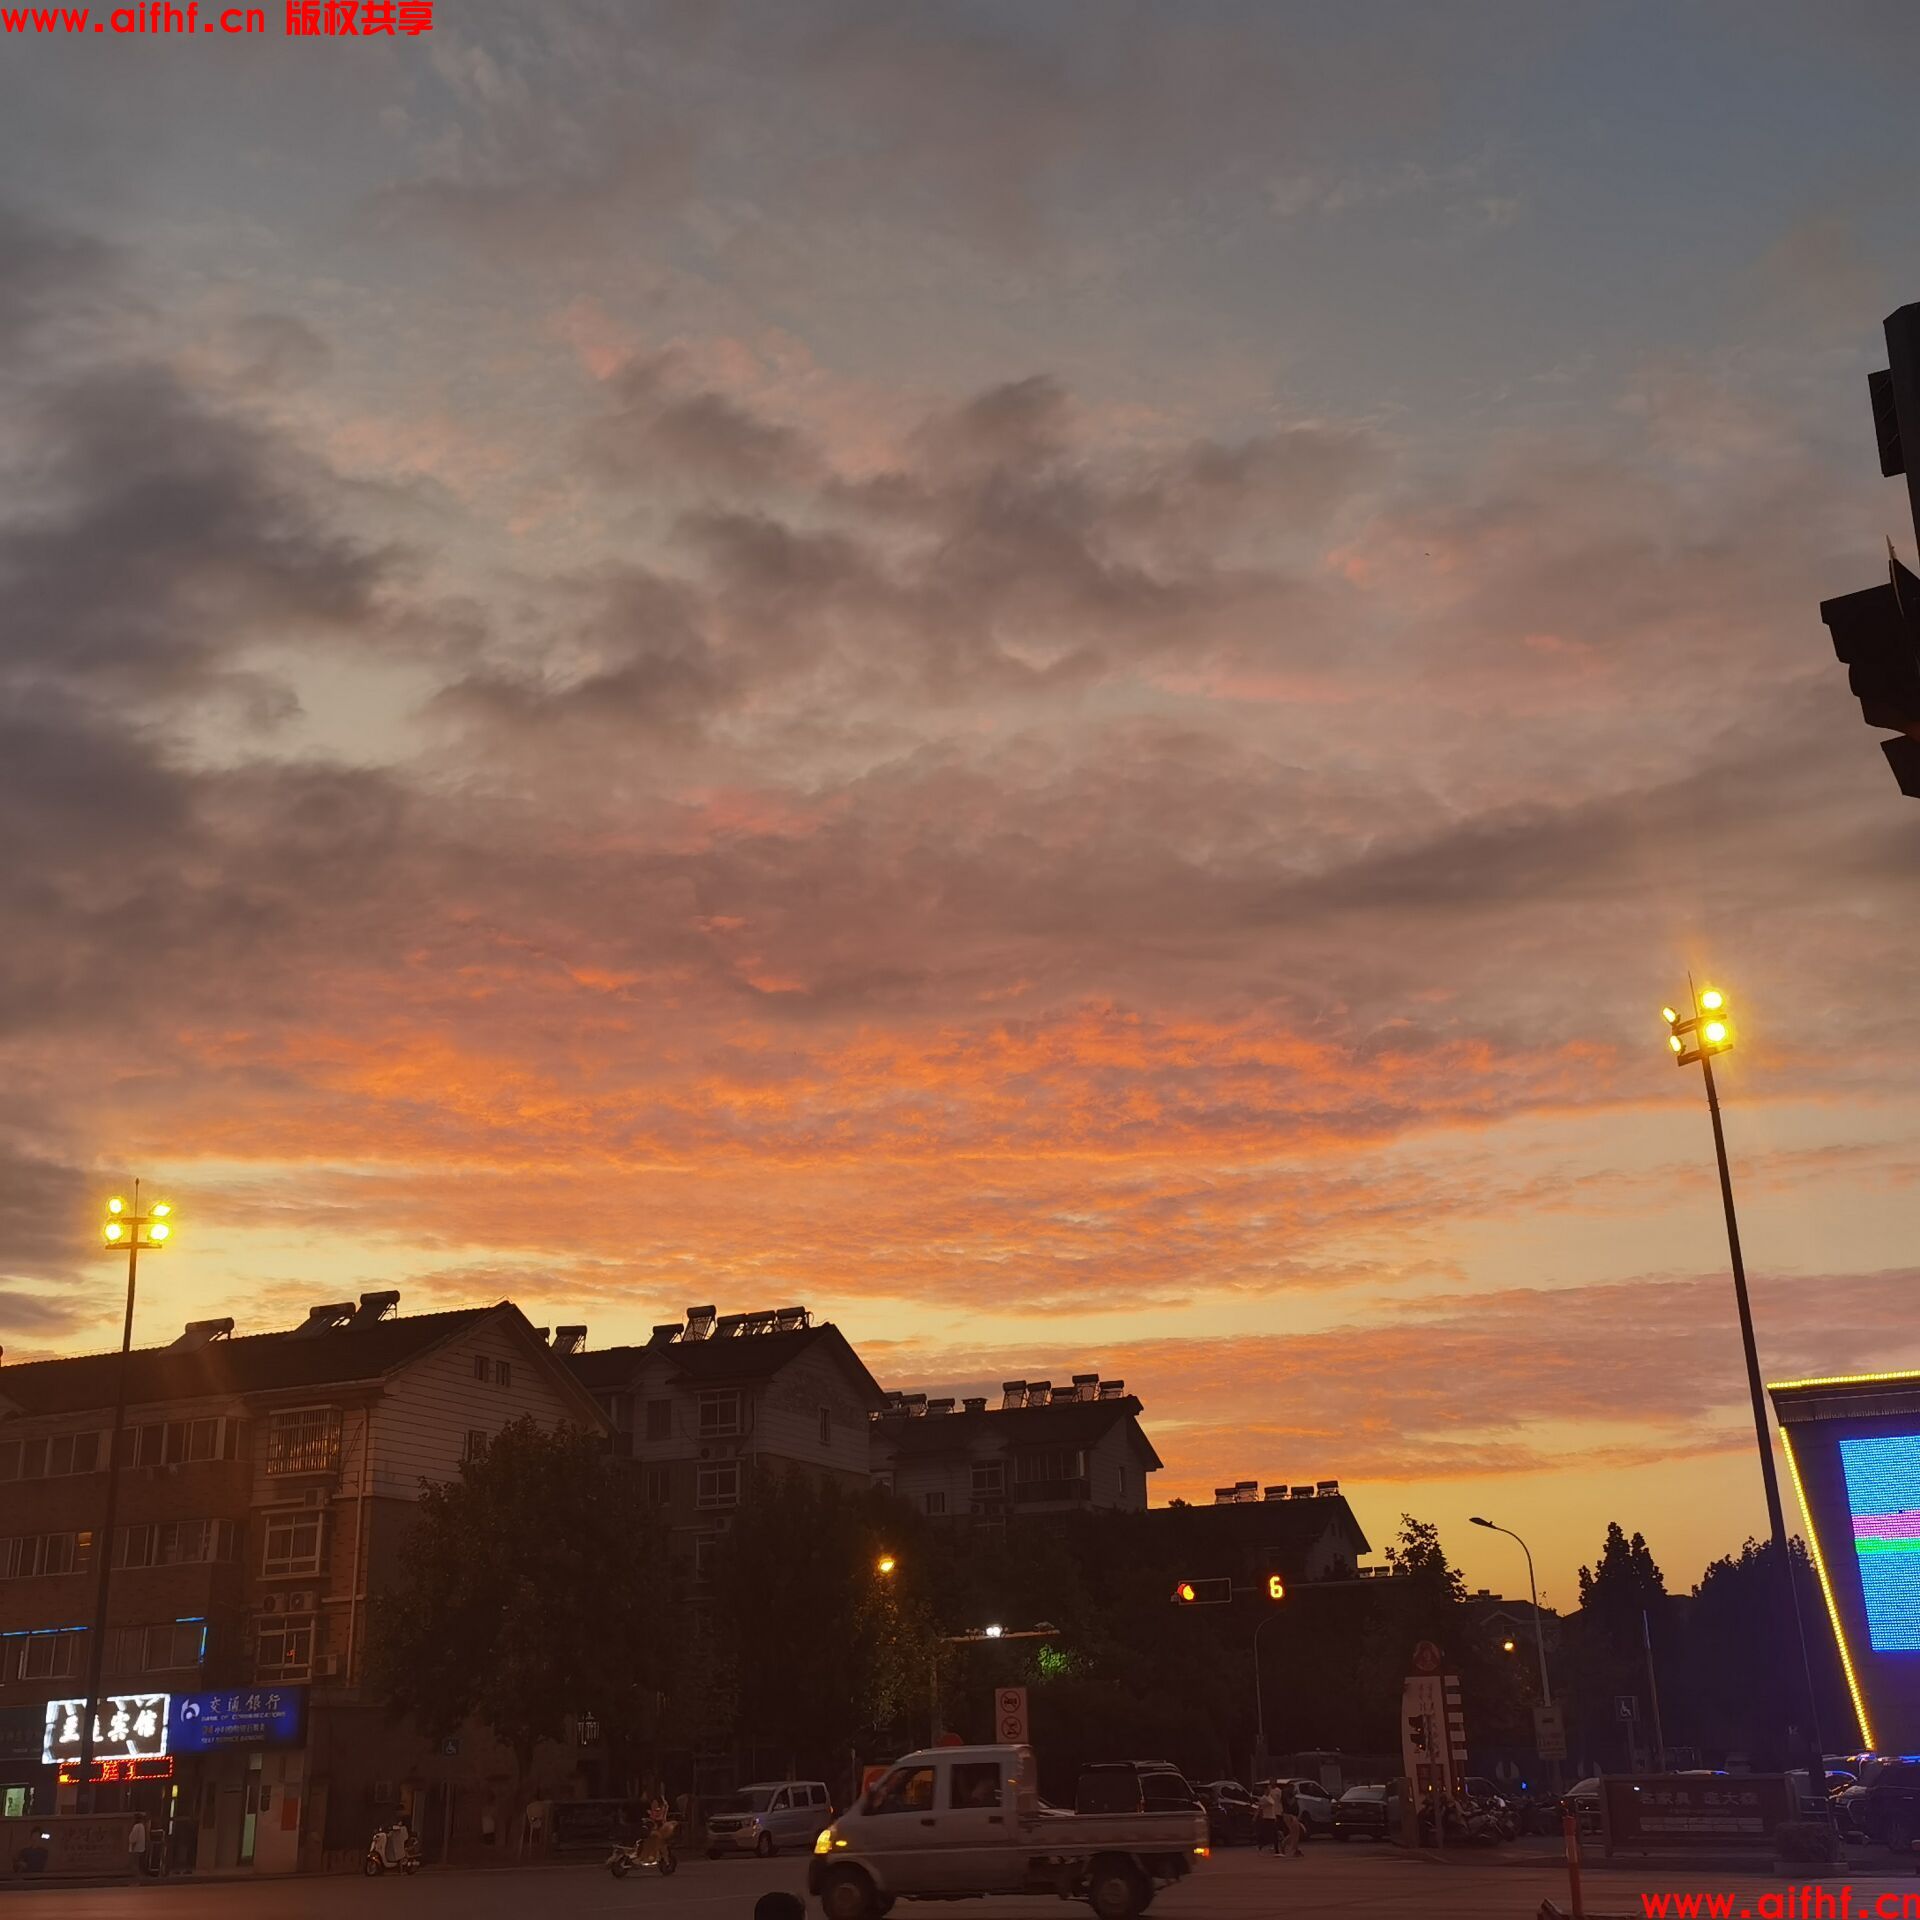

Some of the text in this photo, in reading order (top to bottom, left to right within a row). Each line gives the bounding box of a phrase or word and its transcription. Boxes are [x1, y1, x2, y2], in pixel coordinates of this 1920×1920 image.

[1269, 1575, 1283, 1598] 6
[209, 1693, 281, 1715] 交通银行
